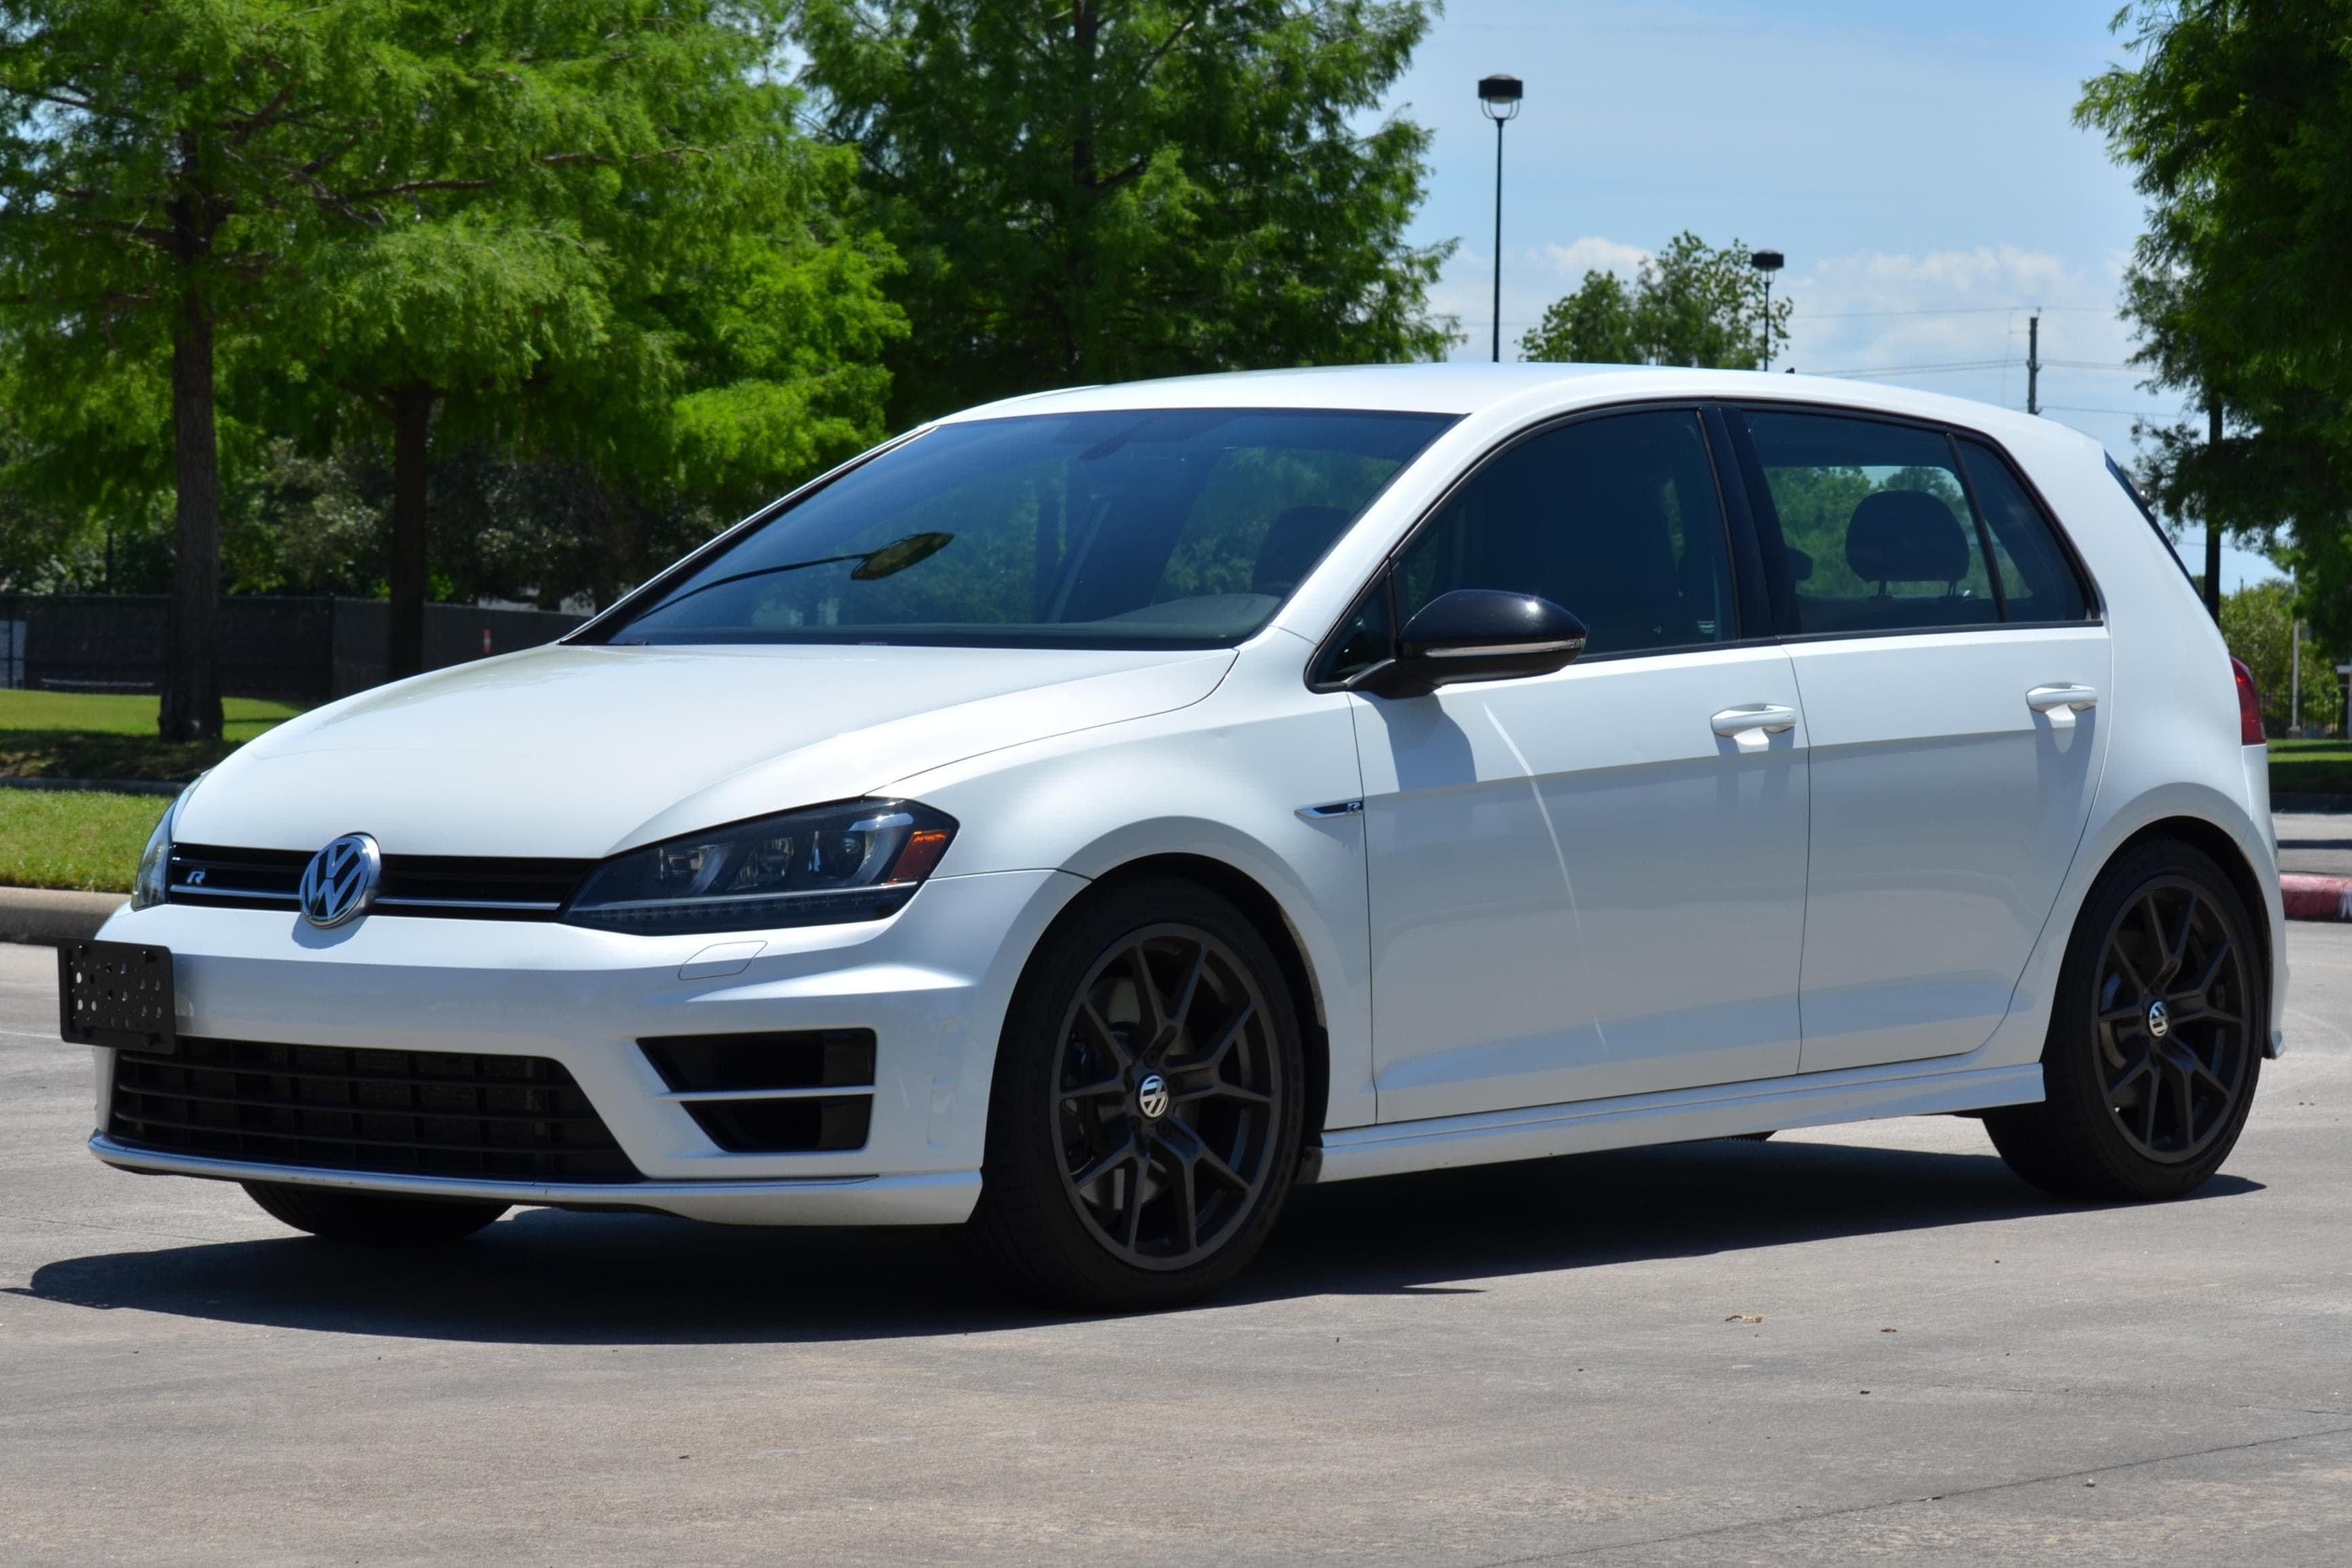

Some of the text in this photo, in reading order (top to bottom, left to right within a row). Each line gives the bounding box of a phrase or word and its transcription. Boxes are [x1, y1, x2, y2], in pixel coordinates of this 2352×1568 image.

[186, 869, 206, 885] R
[299, 834, 374, 923] VW
[1139, 1074, 1169, 1118] VW
